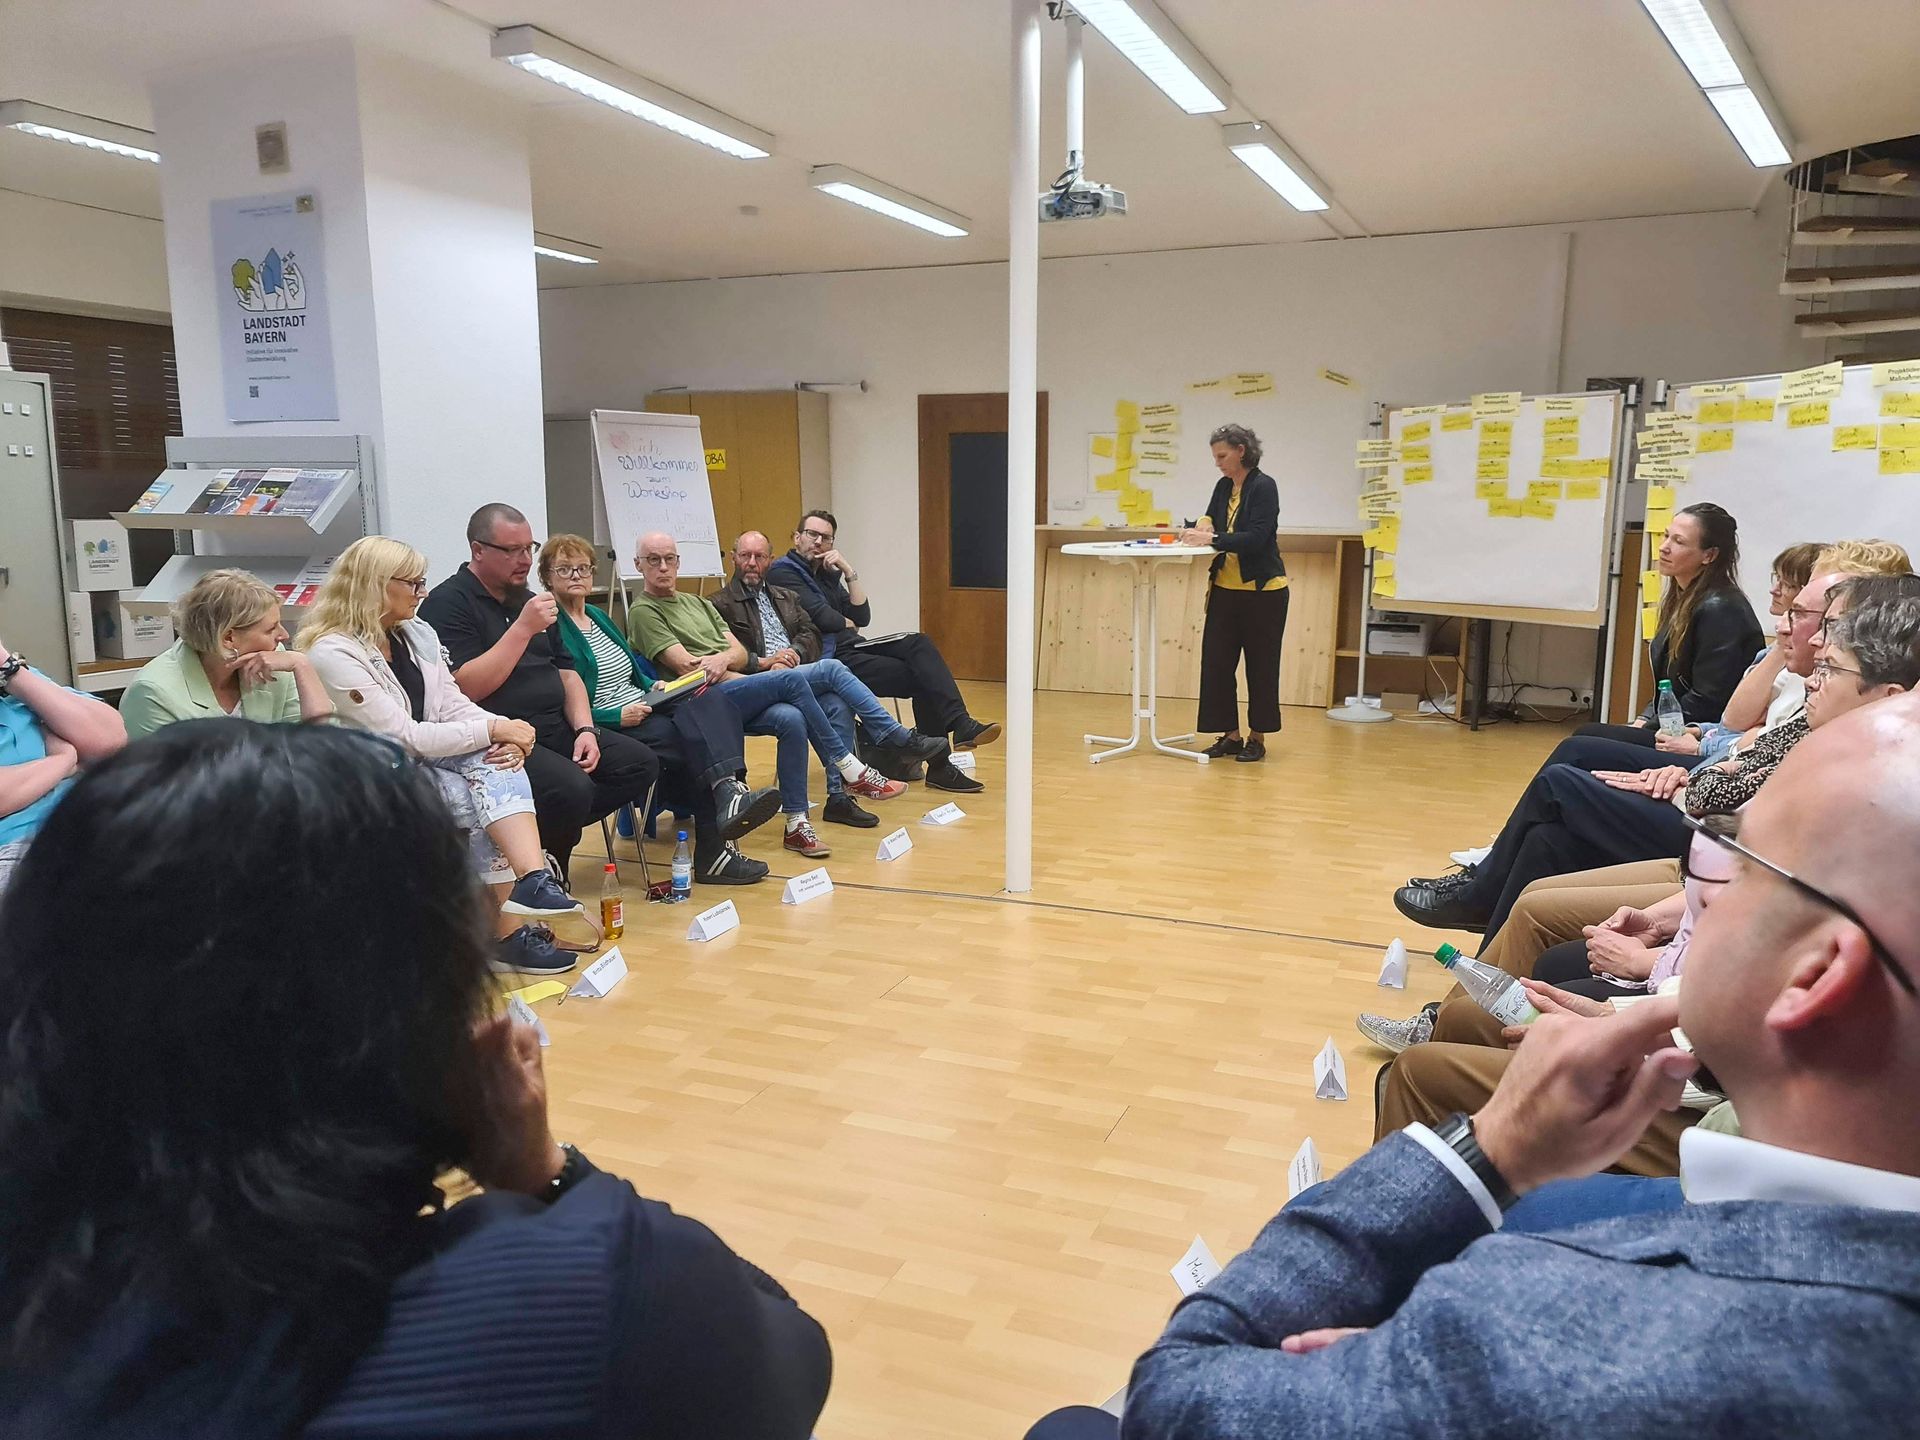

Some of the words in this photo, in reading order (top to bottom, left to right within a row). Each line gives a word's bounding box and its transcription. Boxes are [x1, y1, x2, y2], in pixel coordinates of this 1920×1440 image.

[243, 315, 306, 330] LANDSTADT
[244, 331, 287, 344] BAYERN
[617, 454, 700, 473] Willkommen
[622, 480, 688, 502] Workshop
